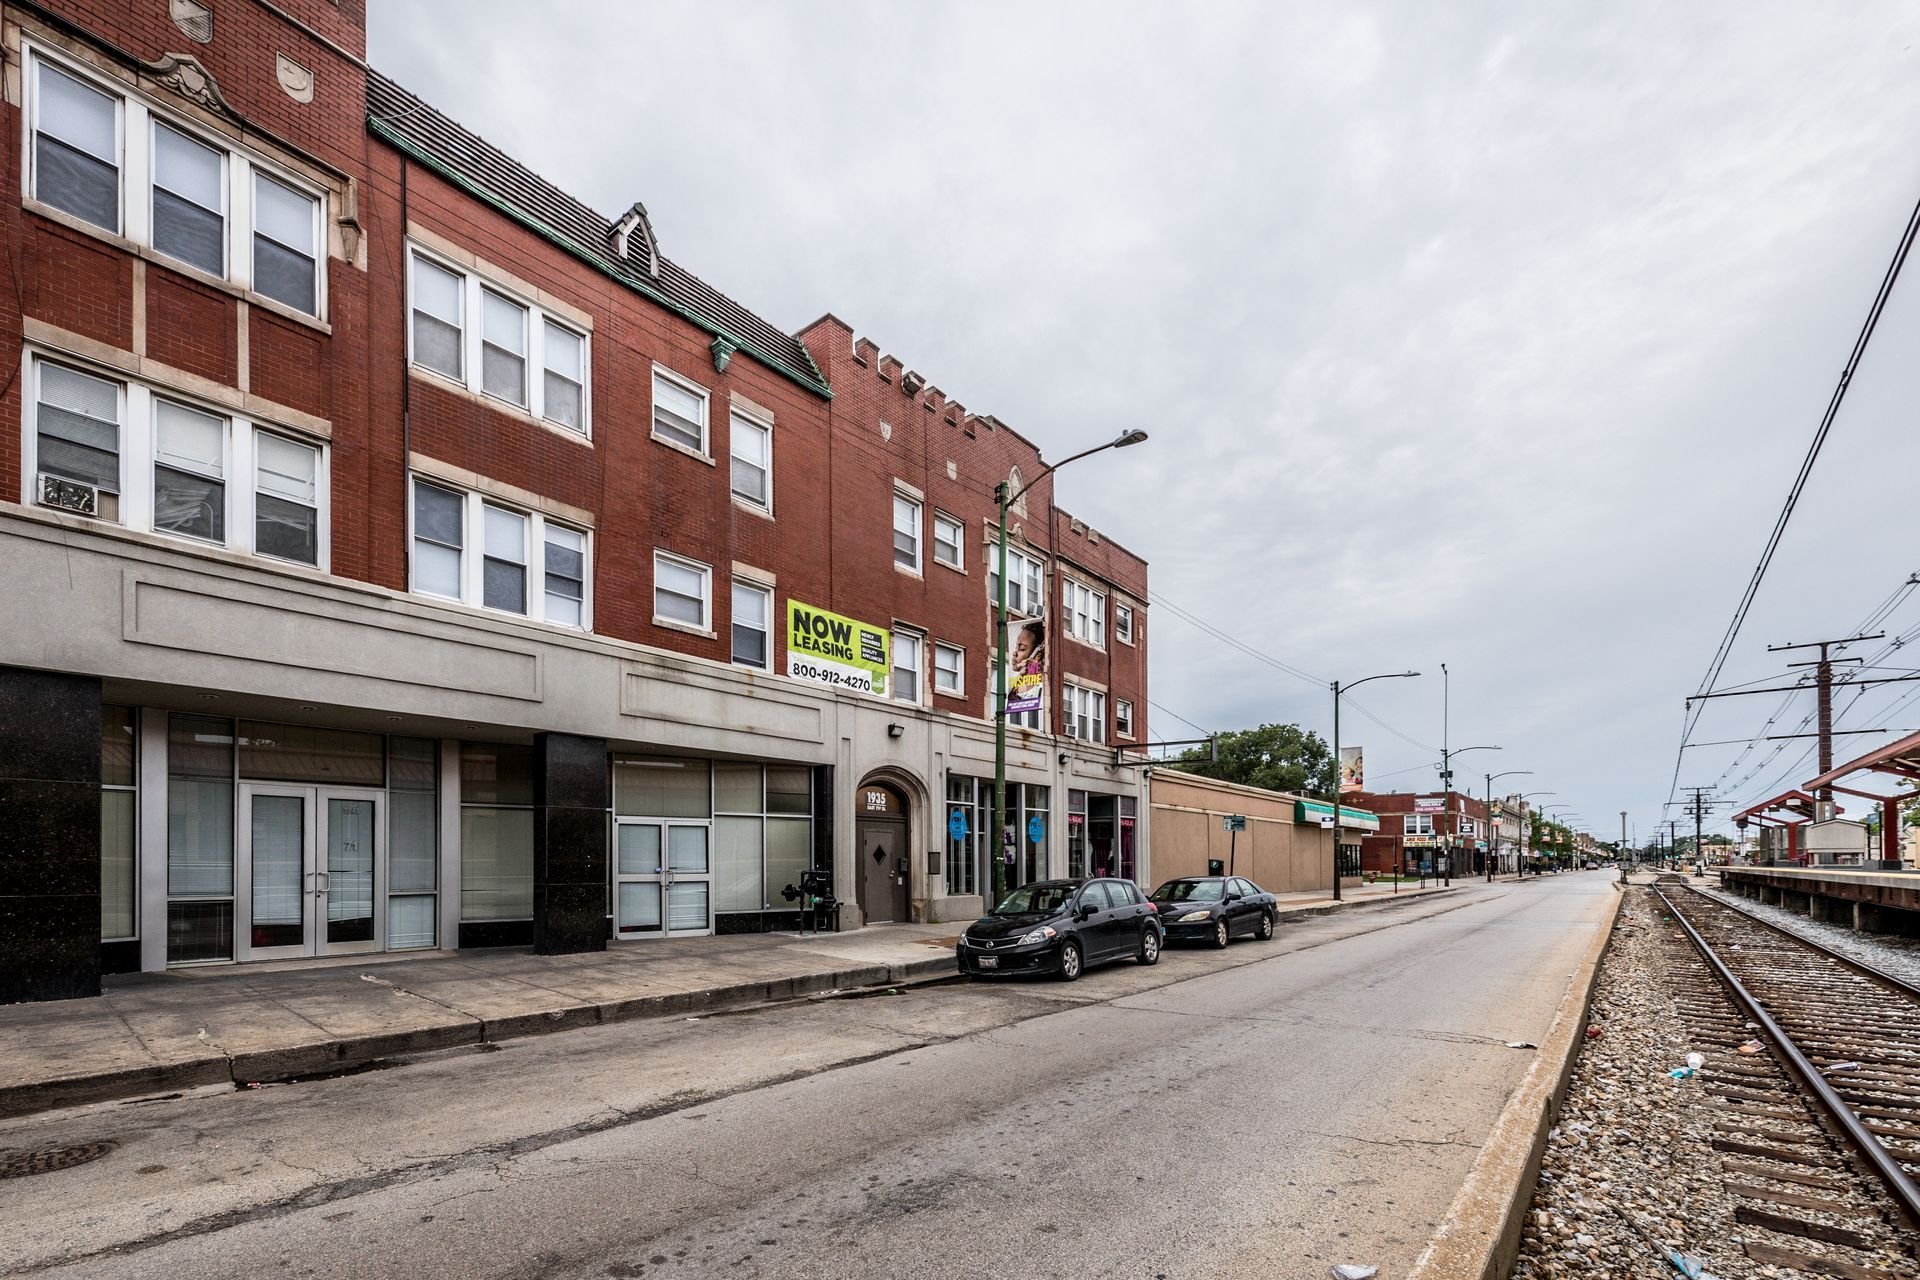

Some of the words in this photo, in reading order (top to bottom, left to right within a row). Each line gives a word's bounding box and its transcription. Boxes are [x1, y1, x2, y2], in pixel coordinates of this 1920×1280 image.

[793, 608, 852, 645] NOW
[793, 633, 853, 661] LEASING
[862, 647, 877, 656] QUALITY
[1028, 662, 1041, 673] WE
[793, 662, 871, 691] 800-912-4270
[1008, 673, 1042, 688] INSPIRE
[866, 791, 886, 804] 1935
